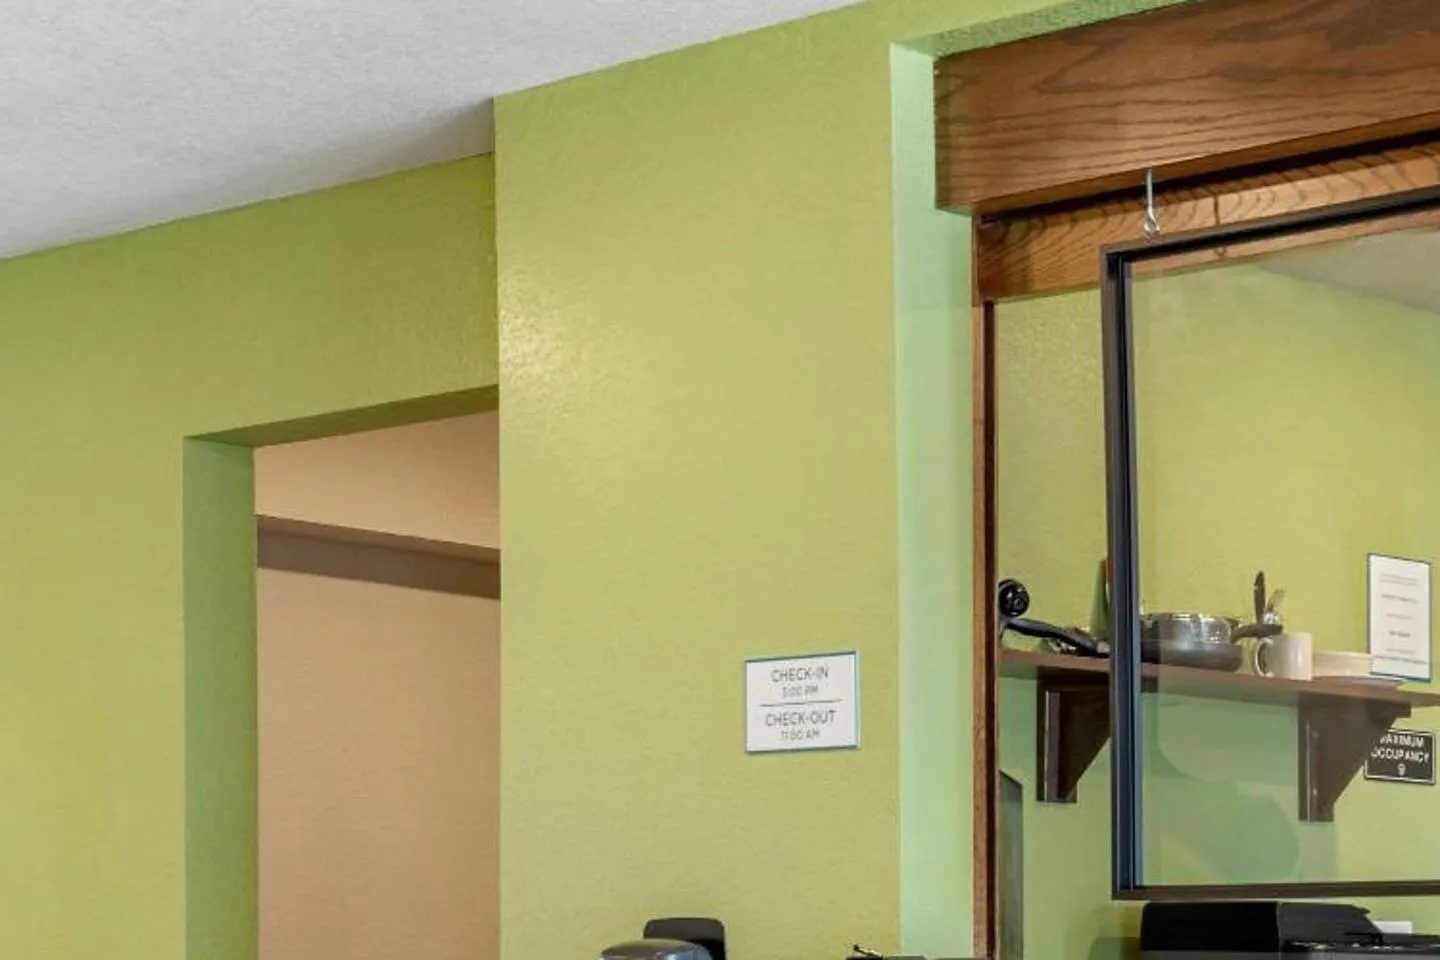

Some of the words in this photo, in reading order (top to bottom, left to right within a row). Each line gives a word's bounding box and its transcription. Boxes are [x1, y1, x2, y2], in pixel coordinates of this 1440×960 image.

[770, 666, 829, 682] CHECK-IN
[804, 685, 819, 695] PM
[765, 709, 837, 726] CHECK-OUT
[806, 728, 820, 738] AM
